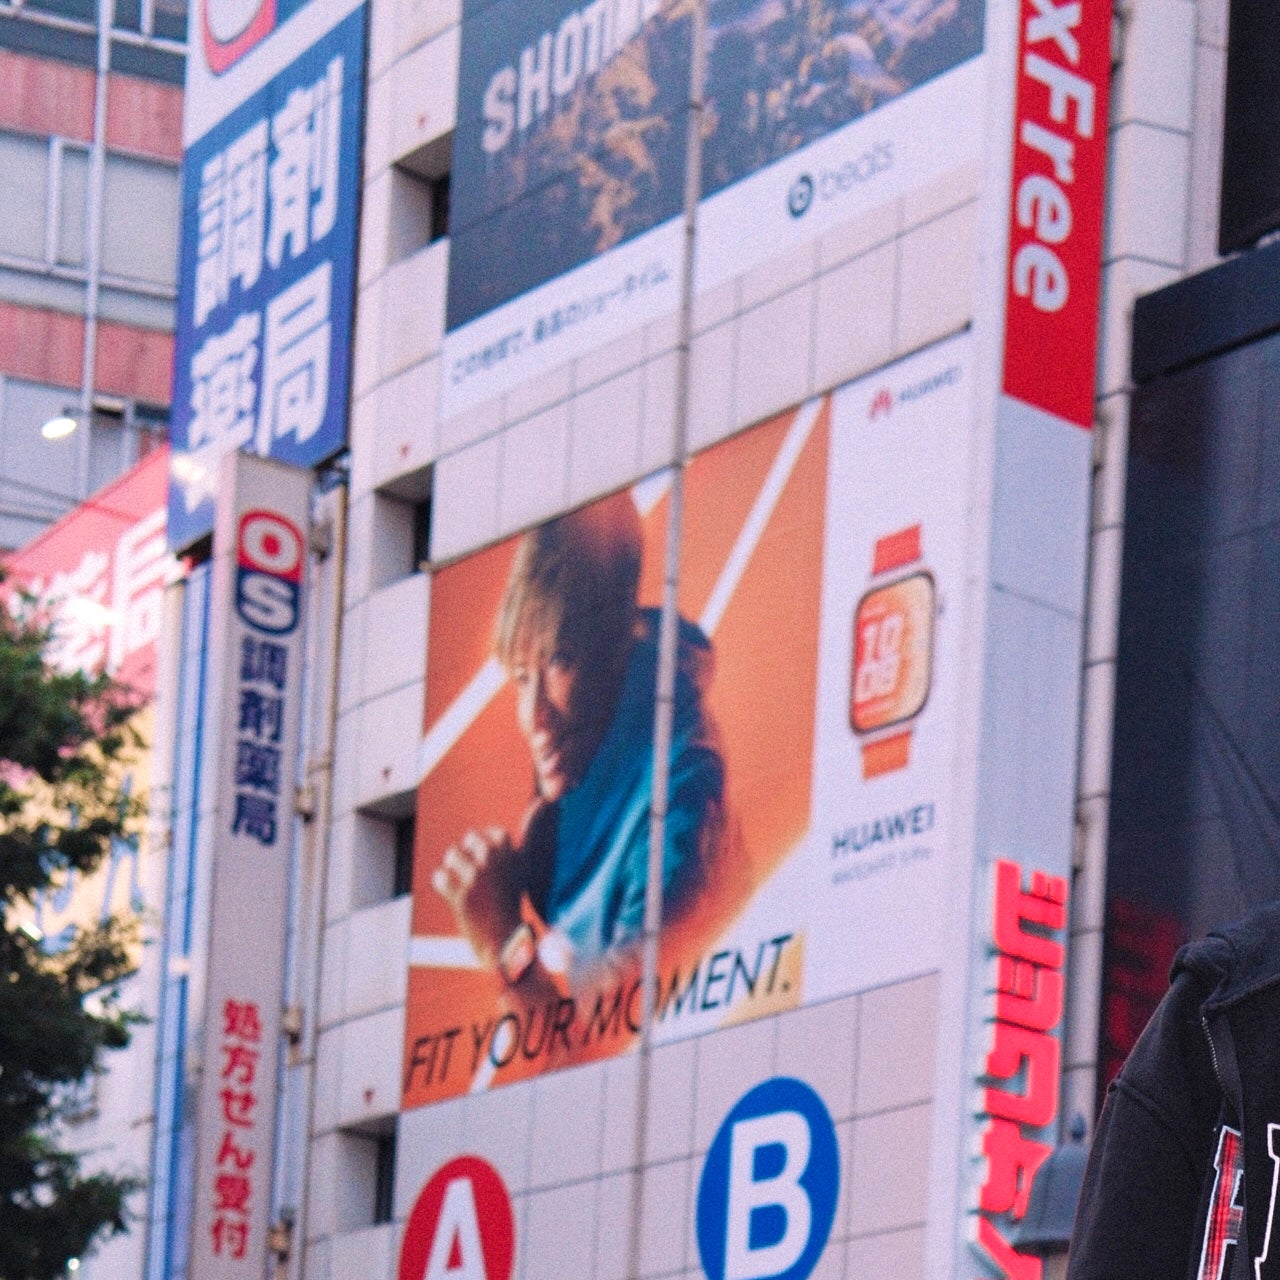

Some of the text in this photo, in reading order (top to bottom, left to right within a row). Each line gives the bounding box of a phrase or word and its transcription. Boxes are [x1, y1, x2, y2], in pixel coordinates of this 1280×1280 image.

[194, 55, 345, 328] 調剤
[187, 259, 334, 458] 薬局
[232, 636, 288, 847] 調剤薬局
[832, 802, 935, 858] HUAWEI
[403, 933, 793, 1093] FIT YOUR MOMENT.
[210, 998, 262, 1261] 処方せん受付
